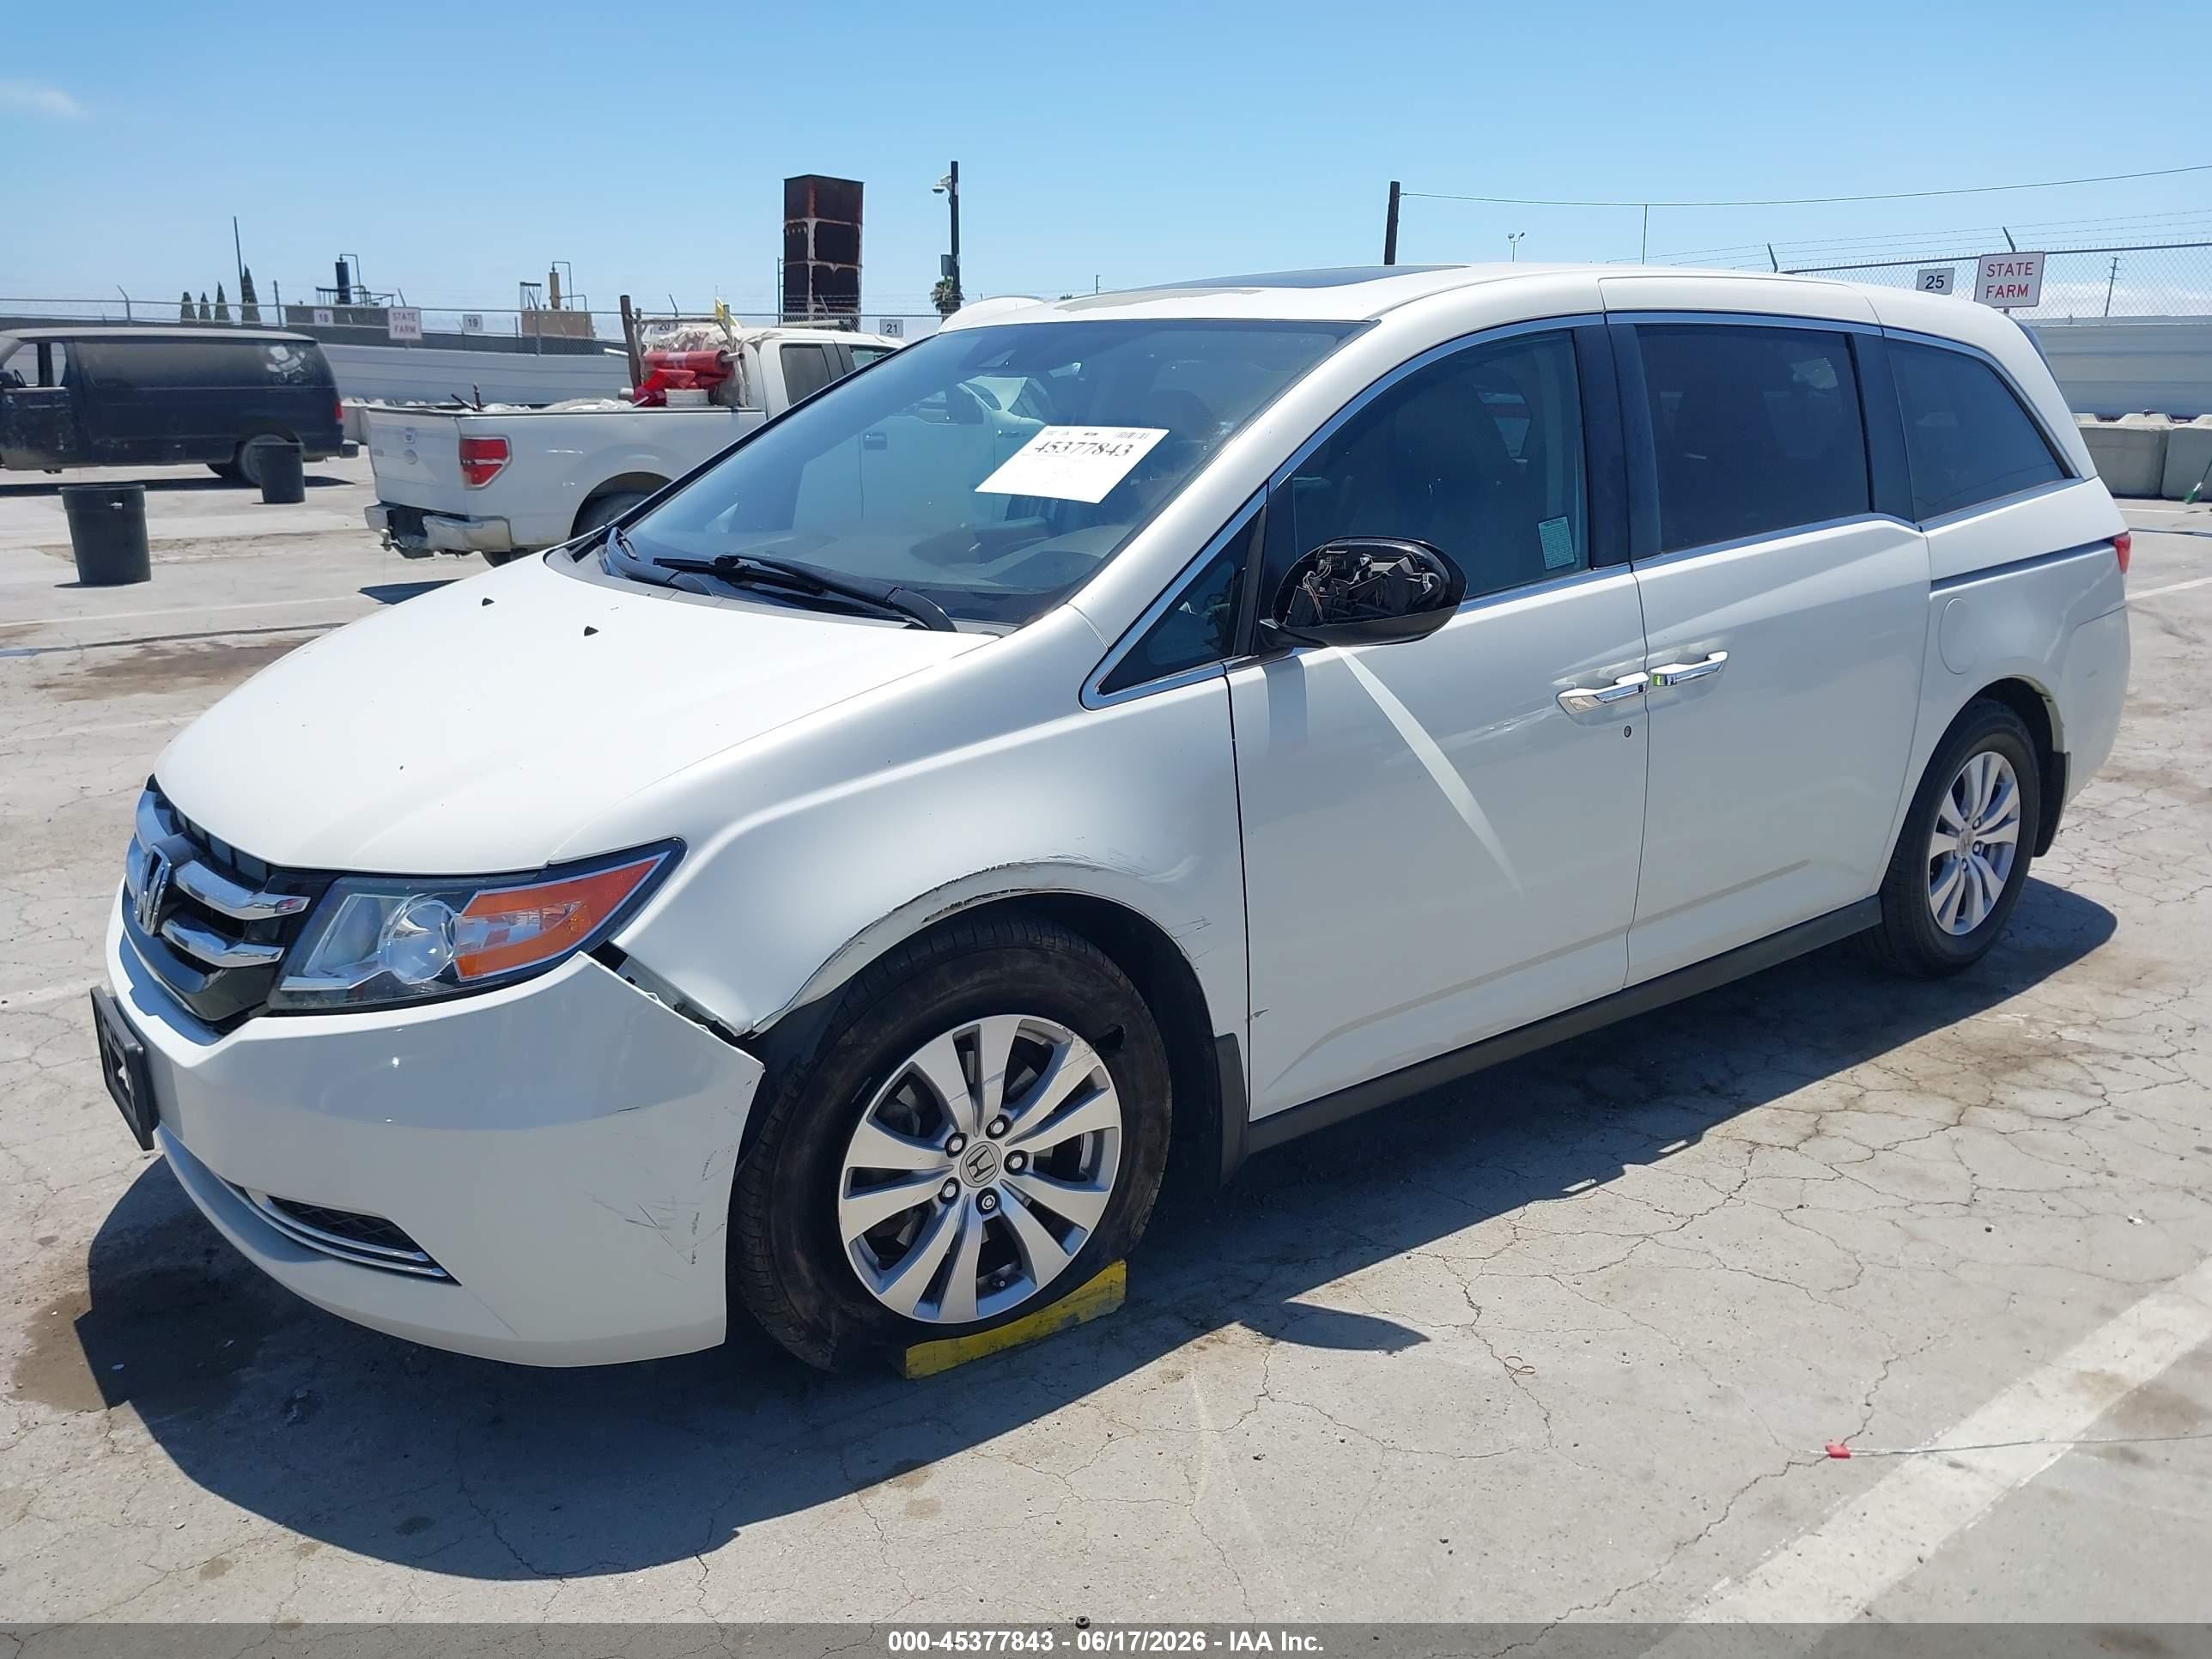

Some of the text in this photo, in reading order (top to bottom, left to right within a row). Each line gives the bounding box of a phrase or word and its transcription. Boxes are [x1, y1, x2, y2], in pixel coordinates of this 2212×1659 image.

[1986, 262, 2034, 277] STATE
[1925, 274, 1945, 289] 25
[1985, 284, 2029, 299] FARM
[319, 313, 330, 323] 18
[392, 312, 416, 322] STATE
[468, 318, 478, 328] 19
[885, 323, 897, 334] 21
[393, 325, 416, 334] FARM
[1035, 441, 1133, 457] 45377843
